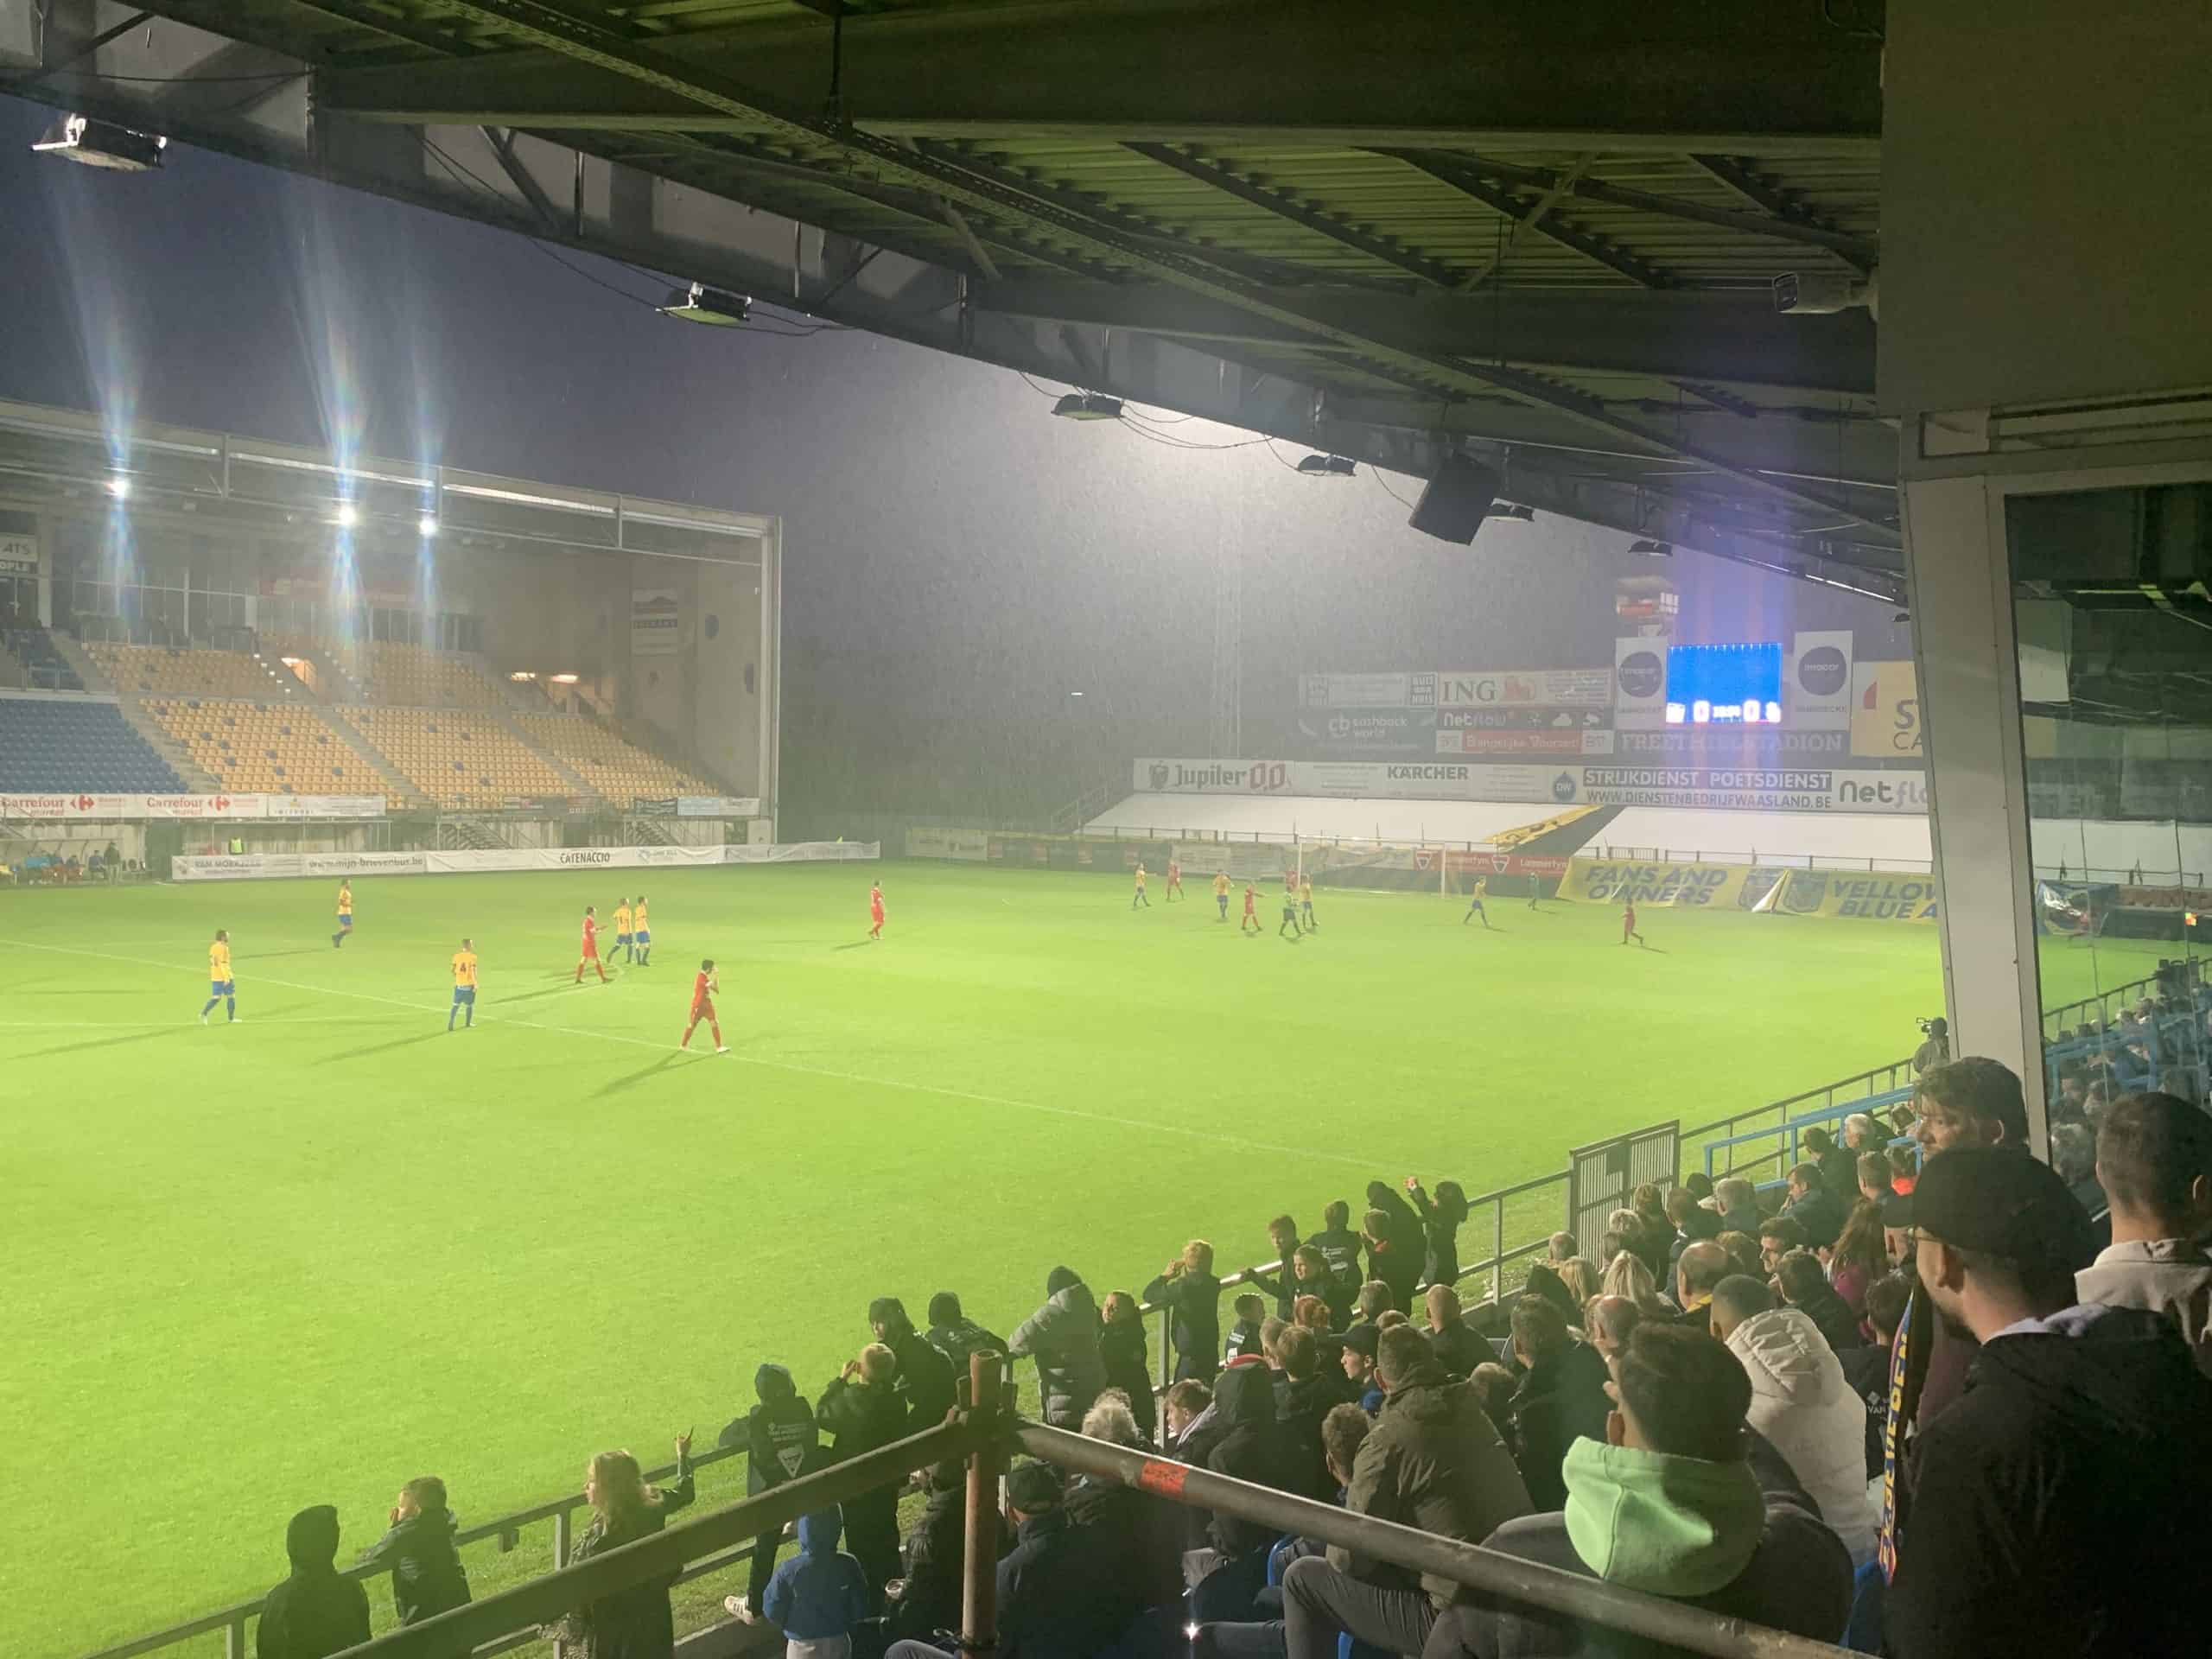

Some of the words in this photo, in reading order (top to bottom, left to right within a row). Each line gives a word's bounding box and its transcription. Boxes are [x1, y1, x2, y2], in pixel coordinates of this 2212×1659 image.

[1443, 680, 1497, 702] ING
[1173, 764, 1246, 788] Jupiler
[1710, 771, 1831, 789] POETSDIENST
[146, 796, 203, 808] Carrefour
[1585, 865, 1659, 884] FANS
[1660, 866, 1728, 887] AND
[1586, 884, 1715, 905] OWNERS
[1839, 899, 1912, 919] BLUE
